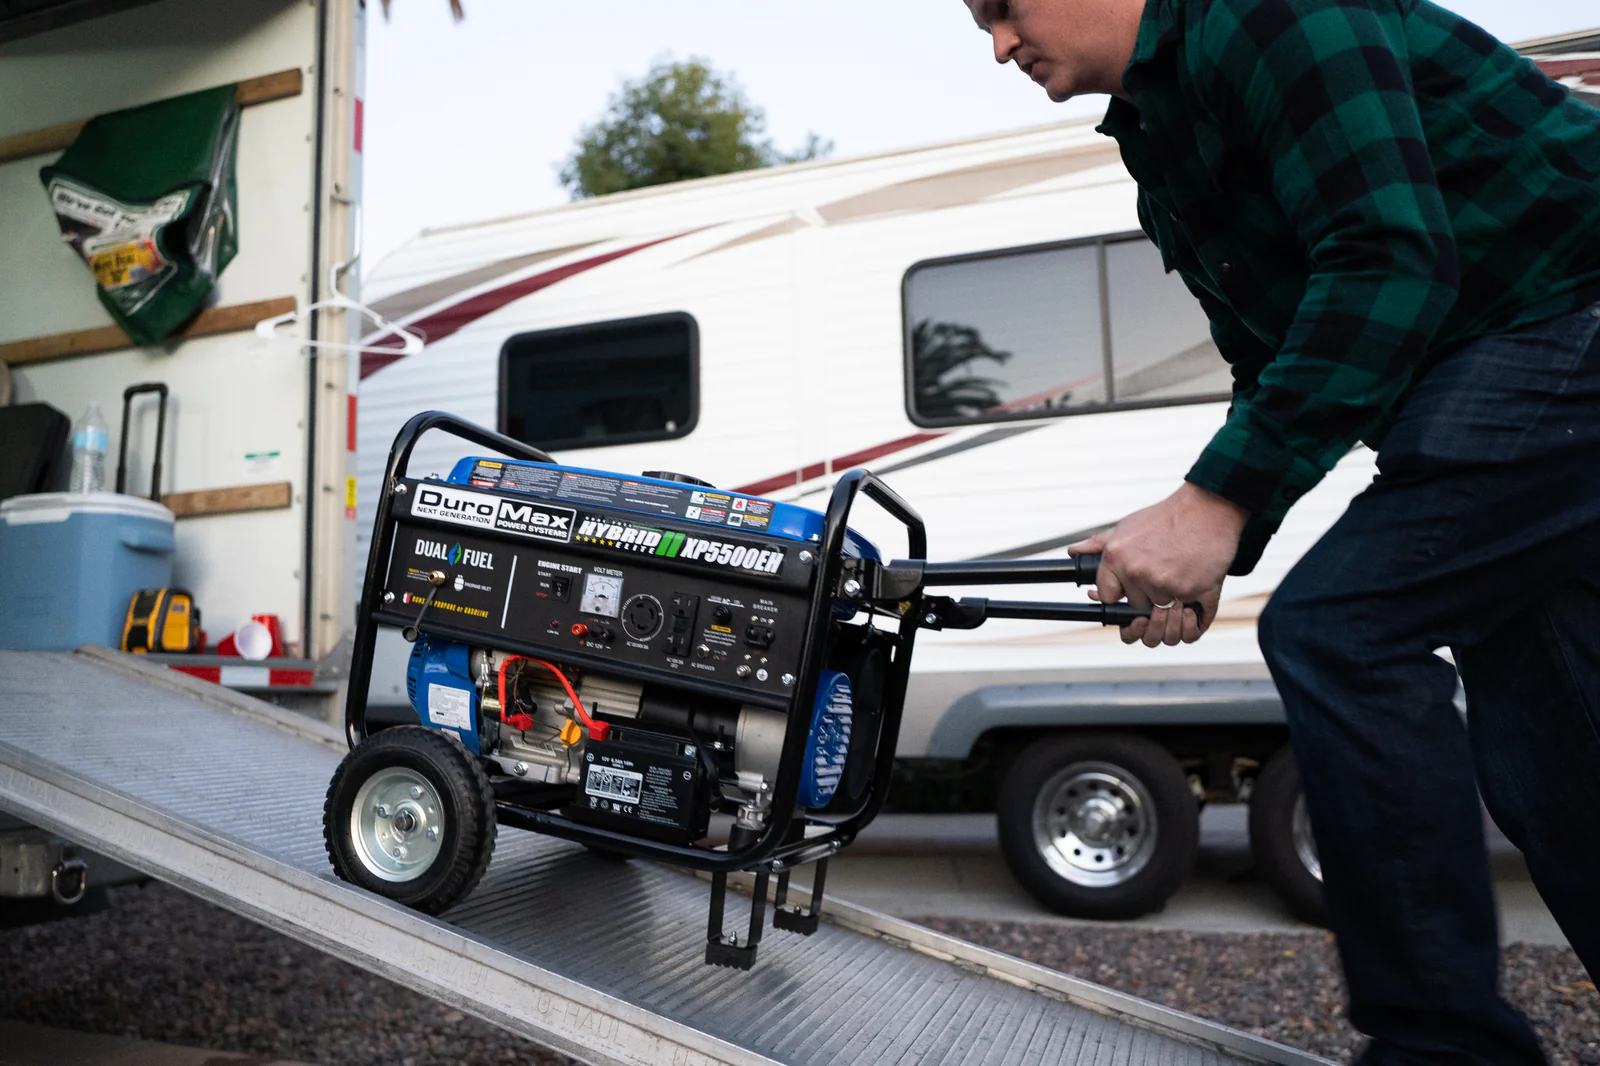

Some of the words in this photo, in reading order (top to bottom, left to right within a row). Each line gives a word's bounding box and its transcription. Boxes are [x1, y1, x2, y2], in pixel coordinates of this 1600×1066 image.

[416, 506, 437, 515] NEXT
[439, 510, 491, 524] GENERATION
[418, 489, 494, 516] Duro
[499, 502, 570, 530] Max
[496, 520, 527, 531] POWER
[527, 525, 567, 538] SYSTEMS
[414, 539, 448, 560] DUAL
[462, 548, 494, 570] FUEL
[578, 519, 662, 547] HYBRID
[680, 537, 784, 574] XP5500EH
[615, 542, 656, 555] ELITE
[537, 560, 561, 570] ENGINE
[561, 564, 582, 574] START
[593, 566, 606, 574] VOLT
[606, 568, 623, 577] METER
[464, 606, 489, 618] GASOLINE
[411, 941, 498, 993] U-HAUL
[536, 991, 625, 1048] U-HAUL
